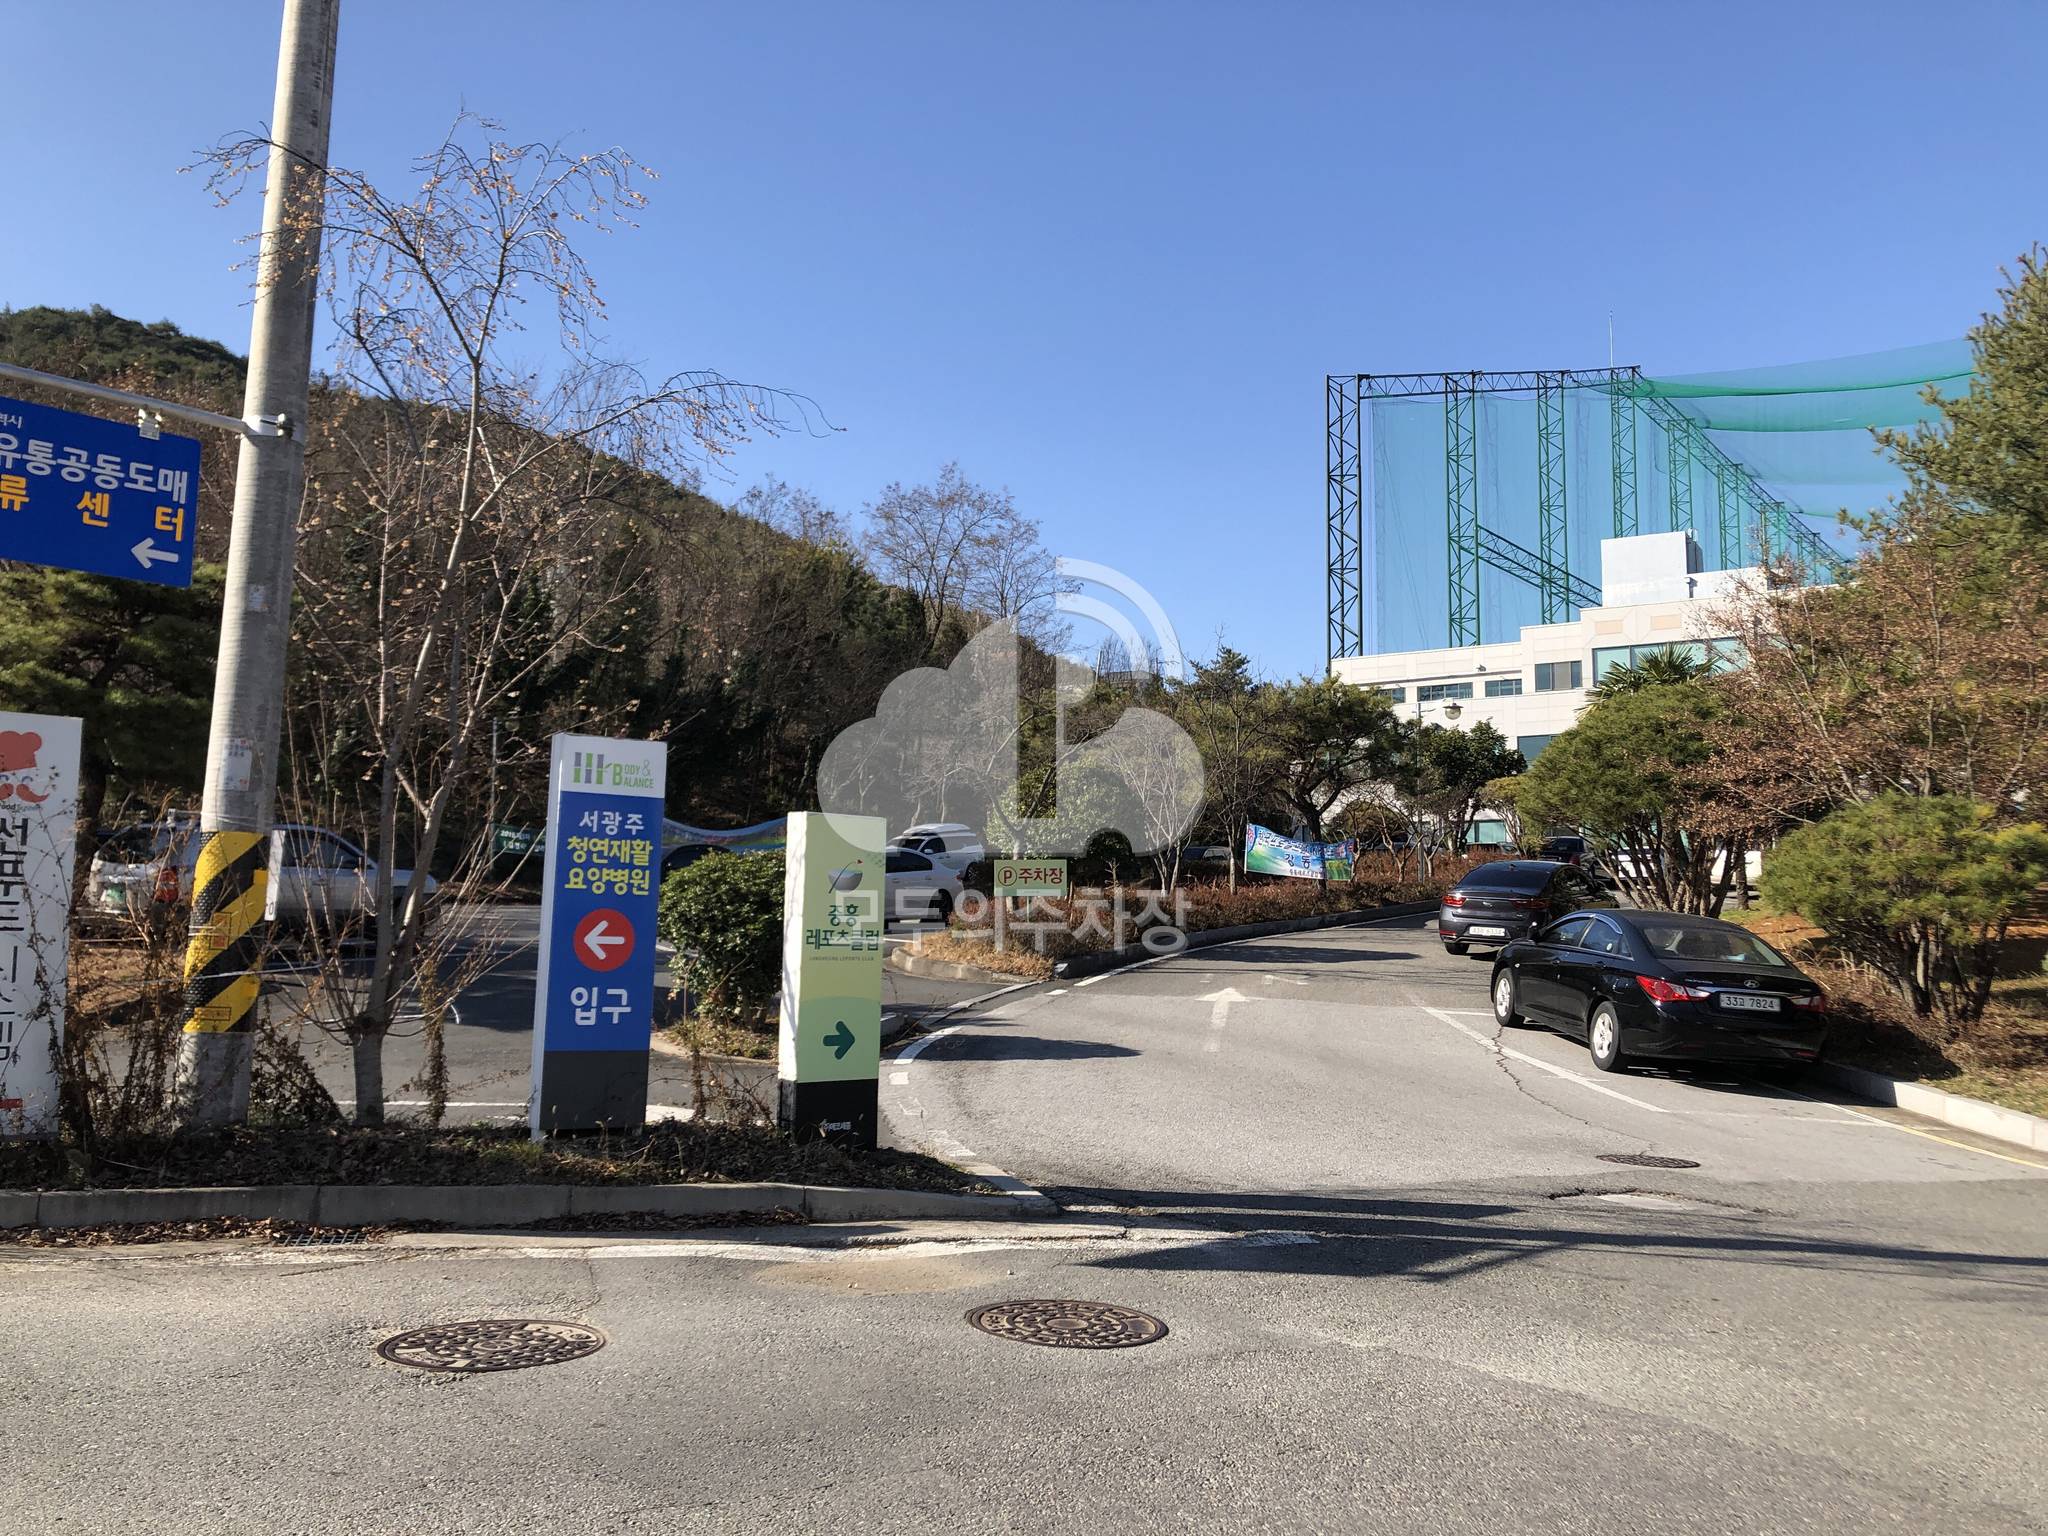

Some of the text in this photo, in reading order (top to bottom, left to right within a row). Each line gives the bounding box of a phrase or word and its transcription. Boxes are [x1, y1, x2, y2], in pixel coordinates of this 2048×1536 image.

[578, 810, 645, 836] 서광주
[566, 836, 653, 866] 청연재활
[564, 867, 651, 896] 요양병원
[1018, 867, 1064, 885] 주차장
[805, 928, 880, 952] 레포츠클럽
[570, 986, 632, 1027] 입구
[1749, 998, 1775, 1009] 7824
